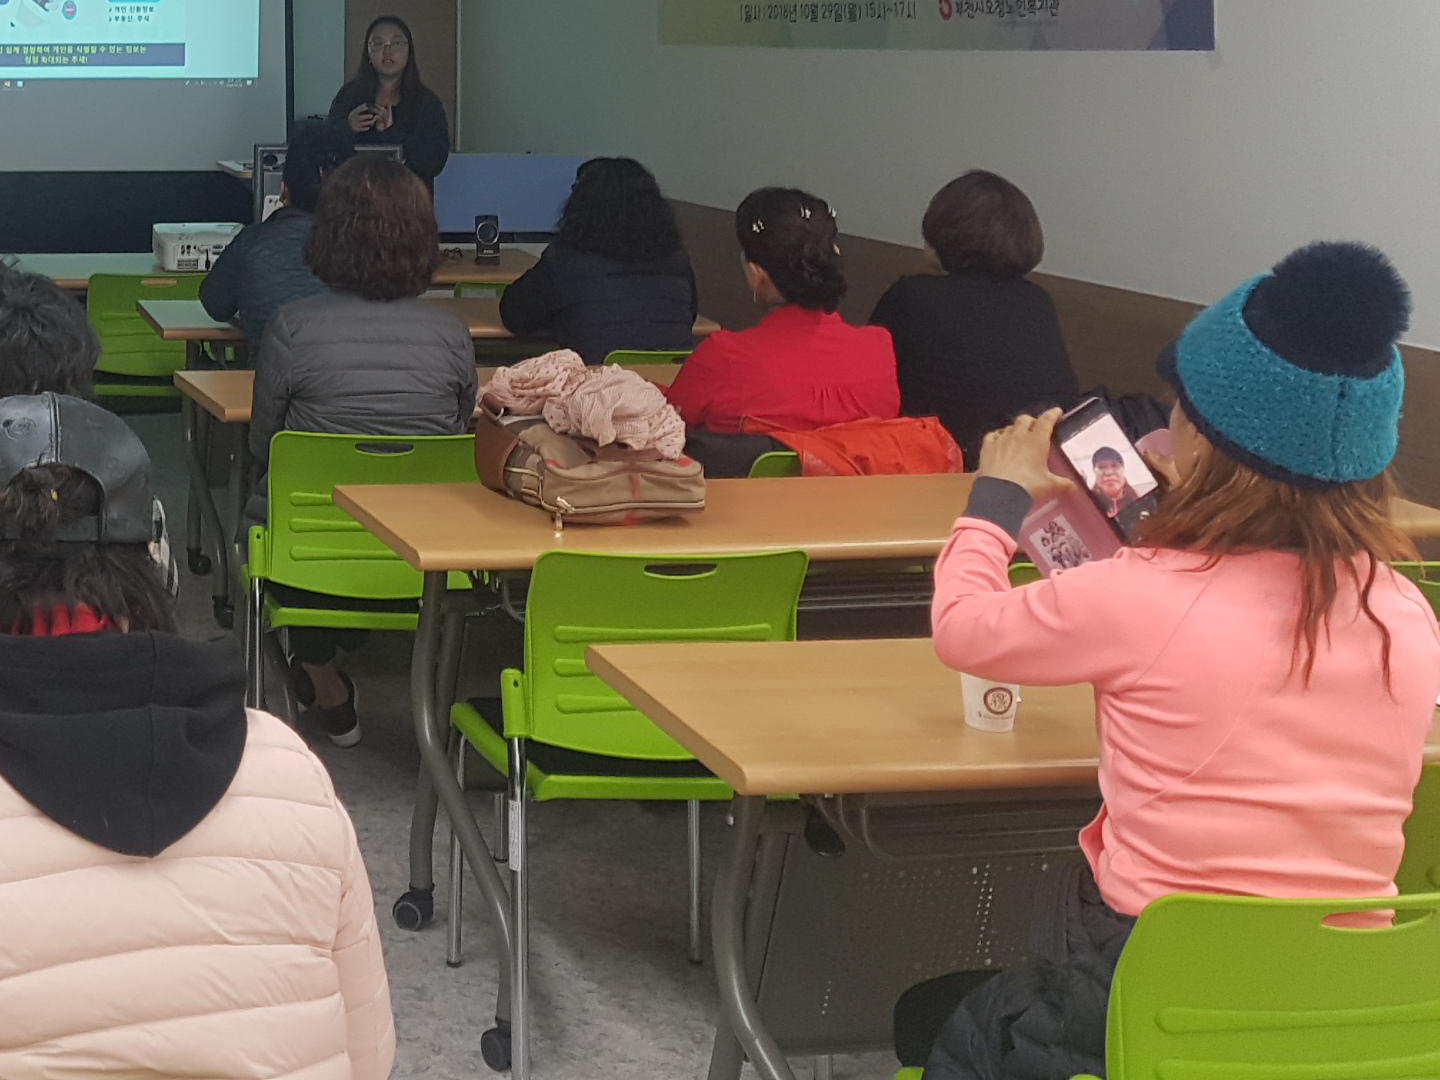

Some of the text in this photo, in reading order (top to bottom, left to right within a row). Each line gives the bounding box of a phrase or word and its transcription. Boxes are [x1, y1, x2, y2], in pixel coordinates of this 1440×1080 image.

[767, 3, 798, 23] 2018년
[800, 3, 819, 23] 10월
[53, 45, 74, 54] 개인을
